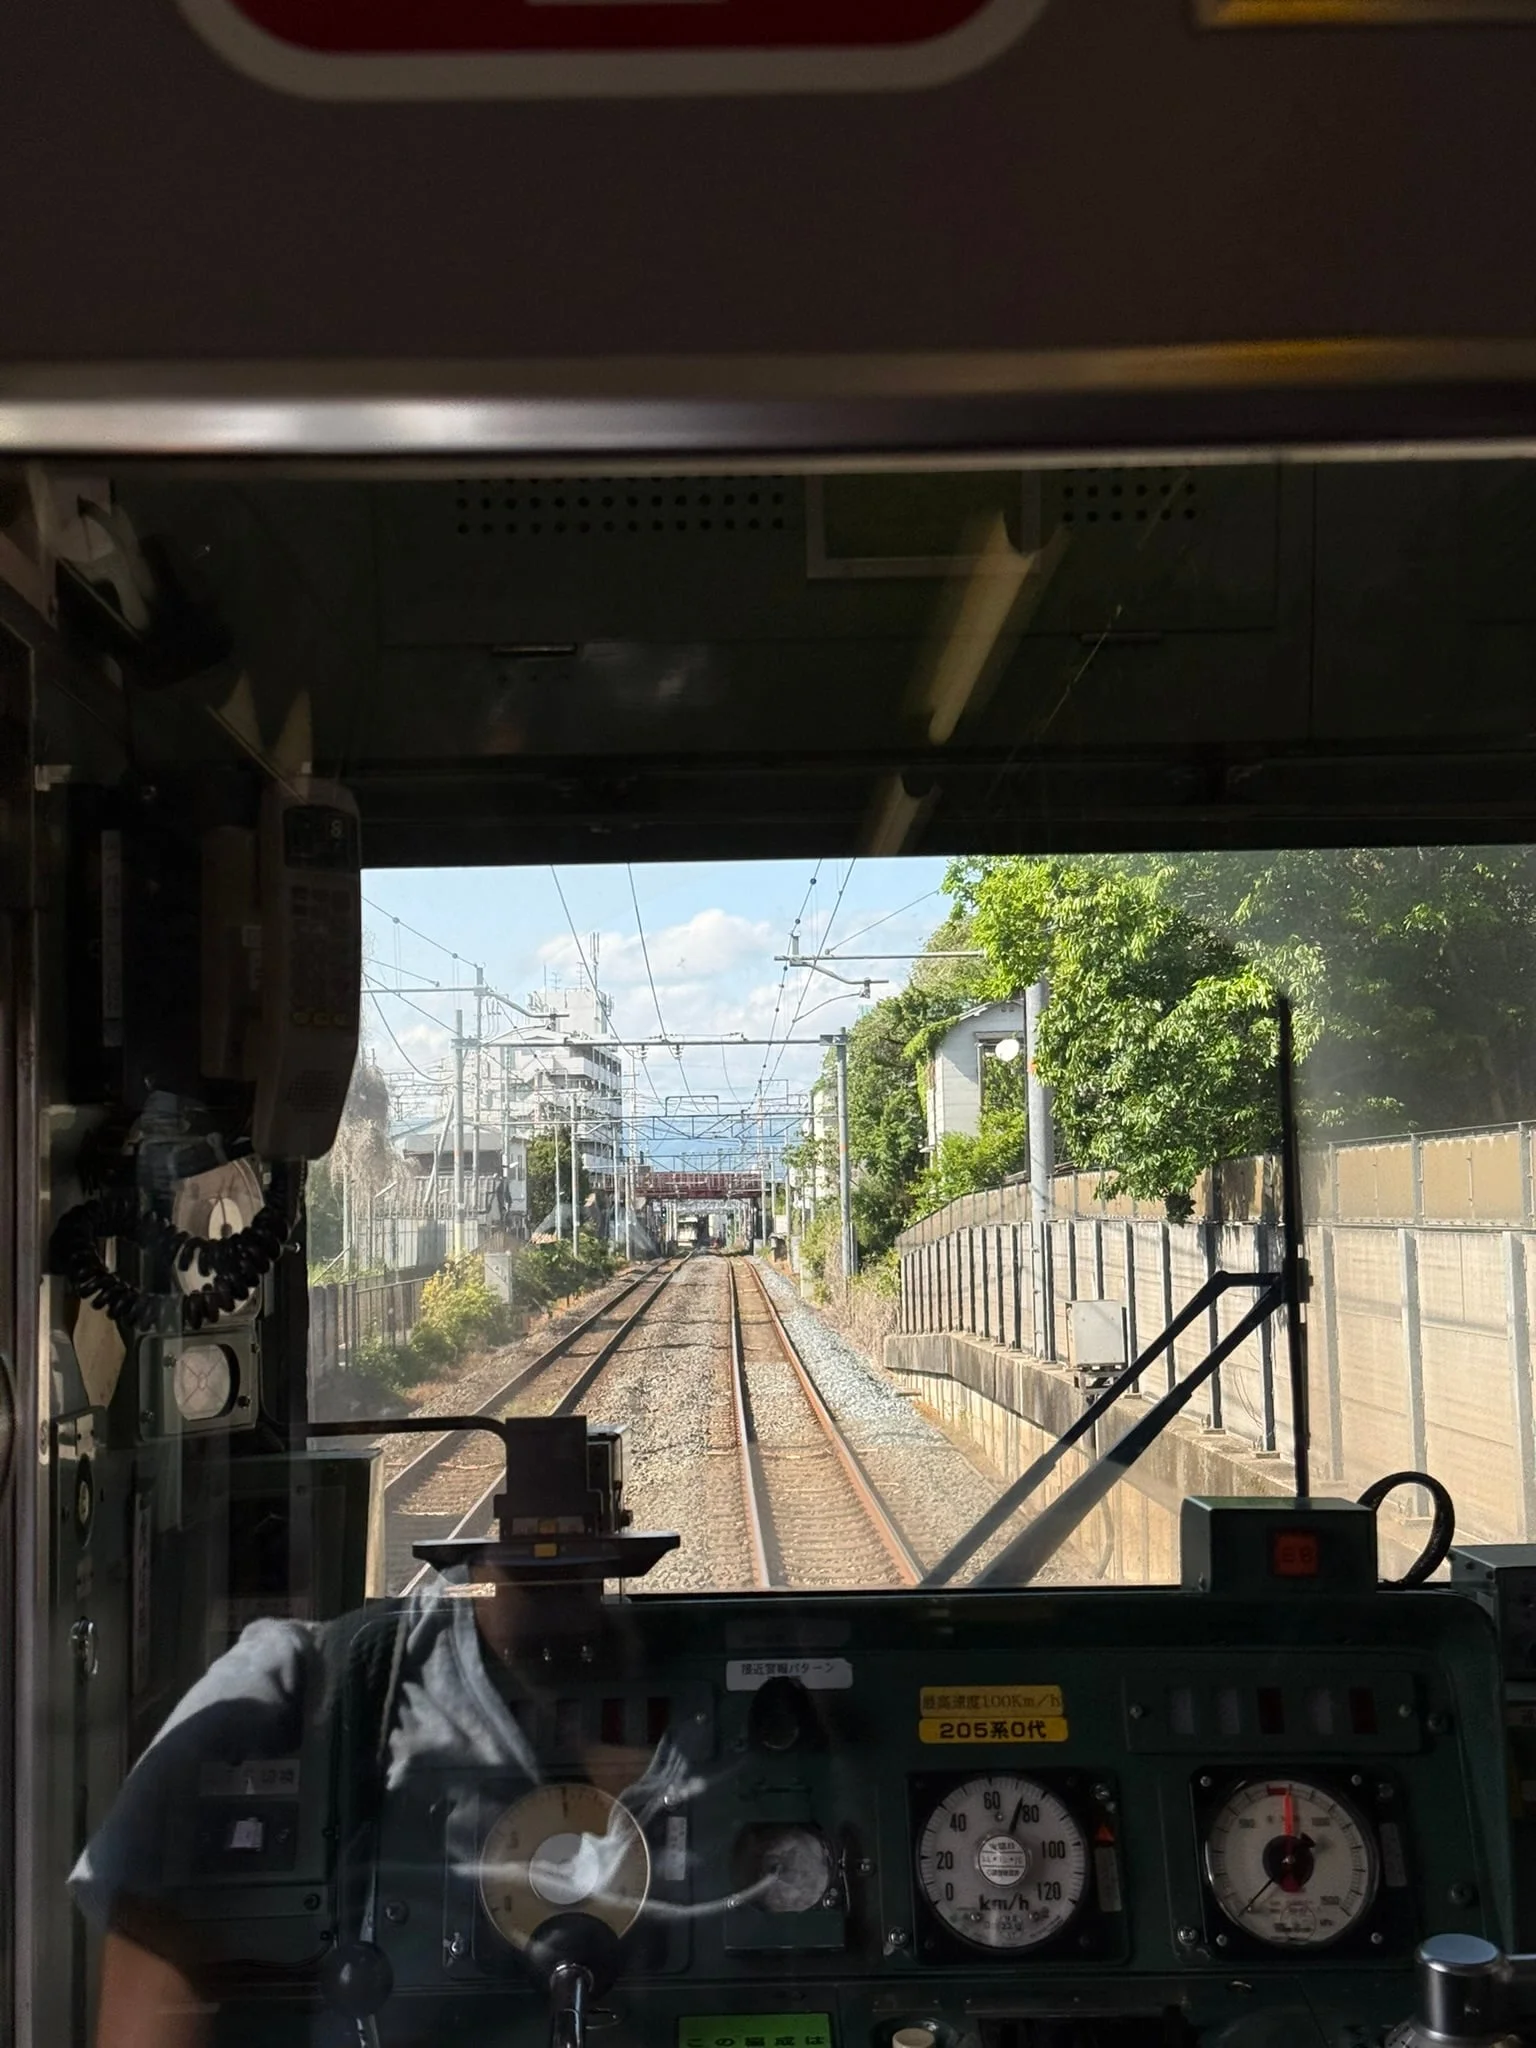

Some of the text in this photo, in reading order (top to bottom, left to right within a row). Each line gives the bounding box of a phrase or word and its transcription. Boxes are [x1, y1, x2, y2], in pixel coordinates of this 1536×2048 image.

[939, 1720, 1047, 1739] 205系0代
[983, 1791, 1001, 1810] 60
[949, 1813, 967, 1832] 40
[1022, 1804, 1039, 1823] 80
[1041, 1840, 1066, 1859] 100
[936, 1851, 953, 1870] 20
[945, 1882, 954, 1901] 0
[1037, 1881, 1062, 1901] 120
[979, 1894, 1030, 1912] km/h
